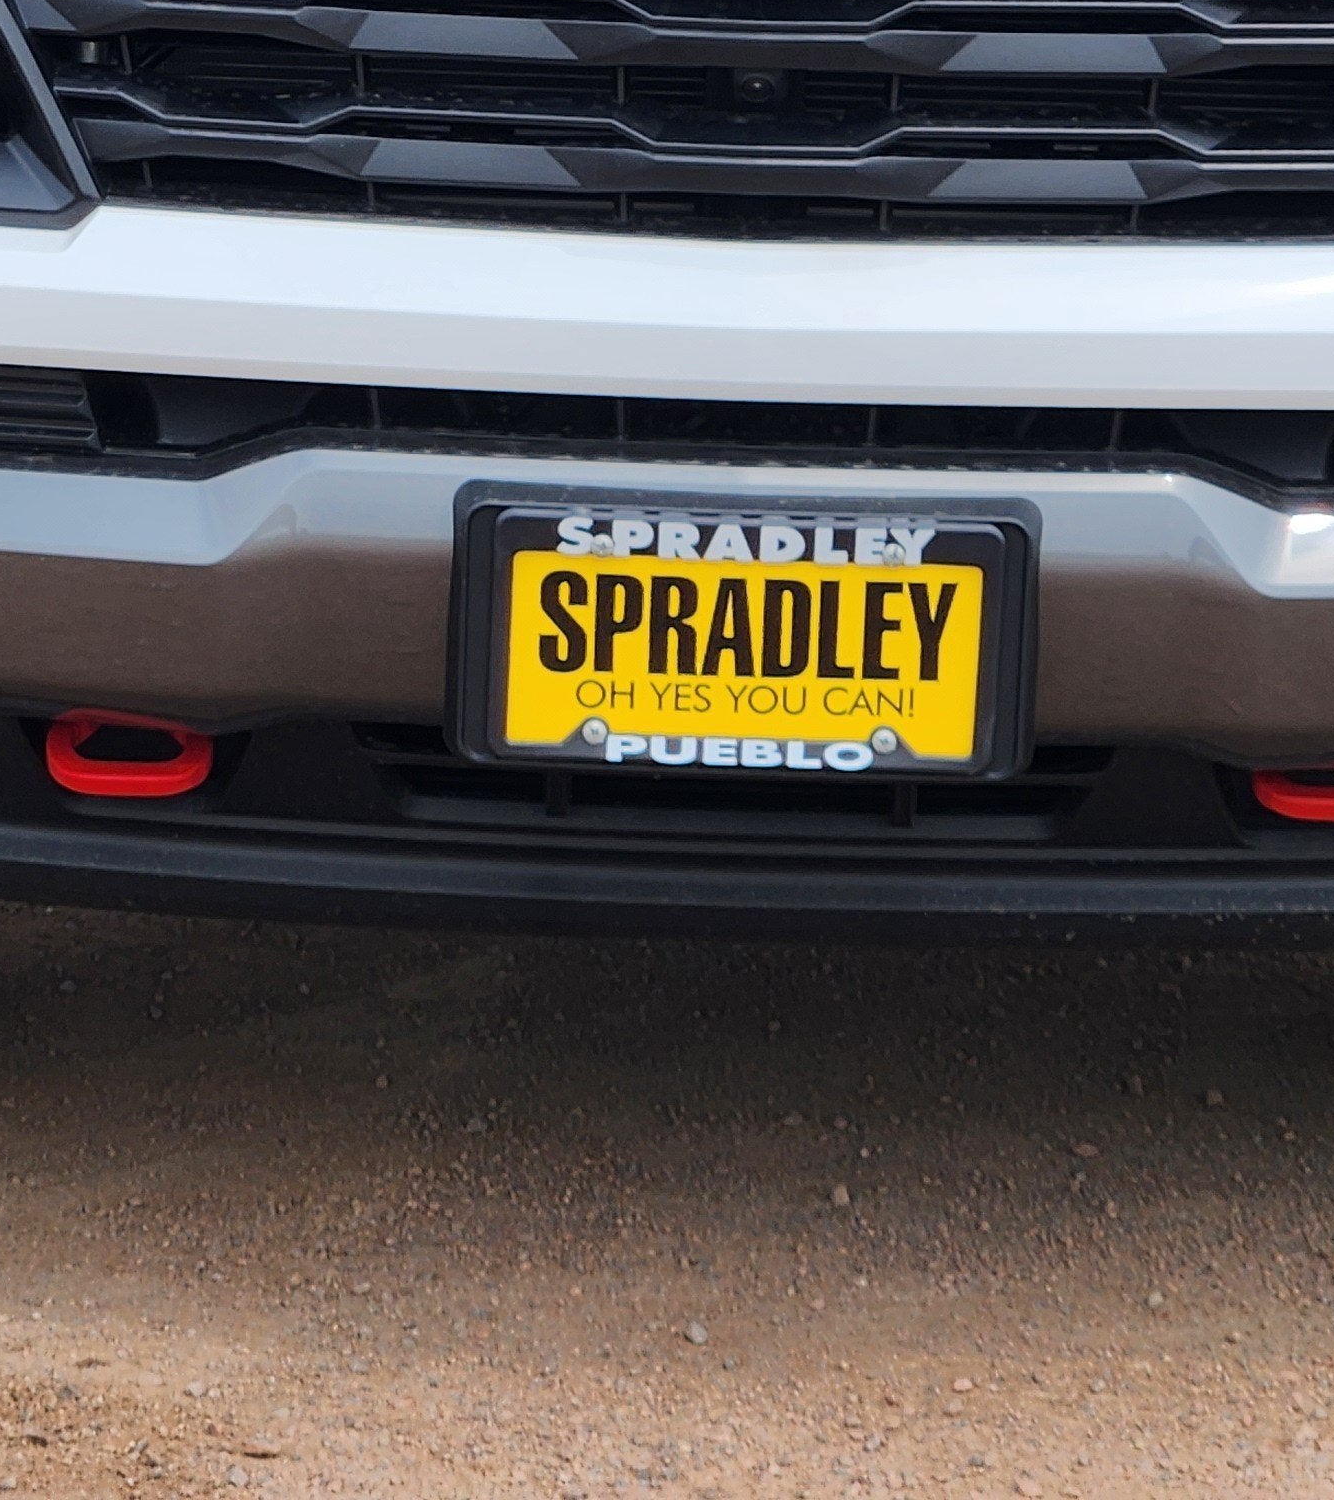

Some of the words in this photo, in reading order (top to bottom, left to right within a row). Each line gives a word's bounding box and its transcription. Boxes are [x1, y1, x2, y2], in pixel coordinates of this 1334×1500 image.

[557, 513, 938, 566] SPRADLEY
[538, 570, 959, 682] SPRADLEY
[575, 679, 635, 710] OH
[649, 682, 712, 713] YES
[725, 685, 808, 716] YOU
[822, 687, 916, 718] CAN!
[604, 733, 875, 772] PUEBLO
